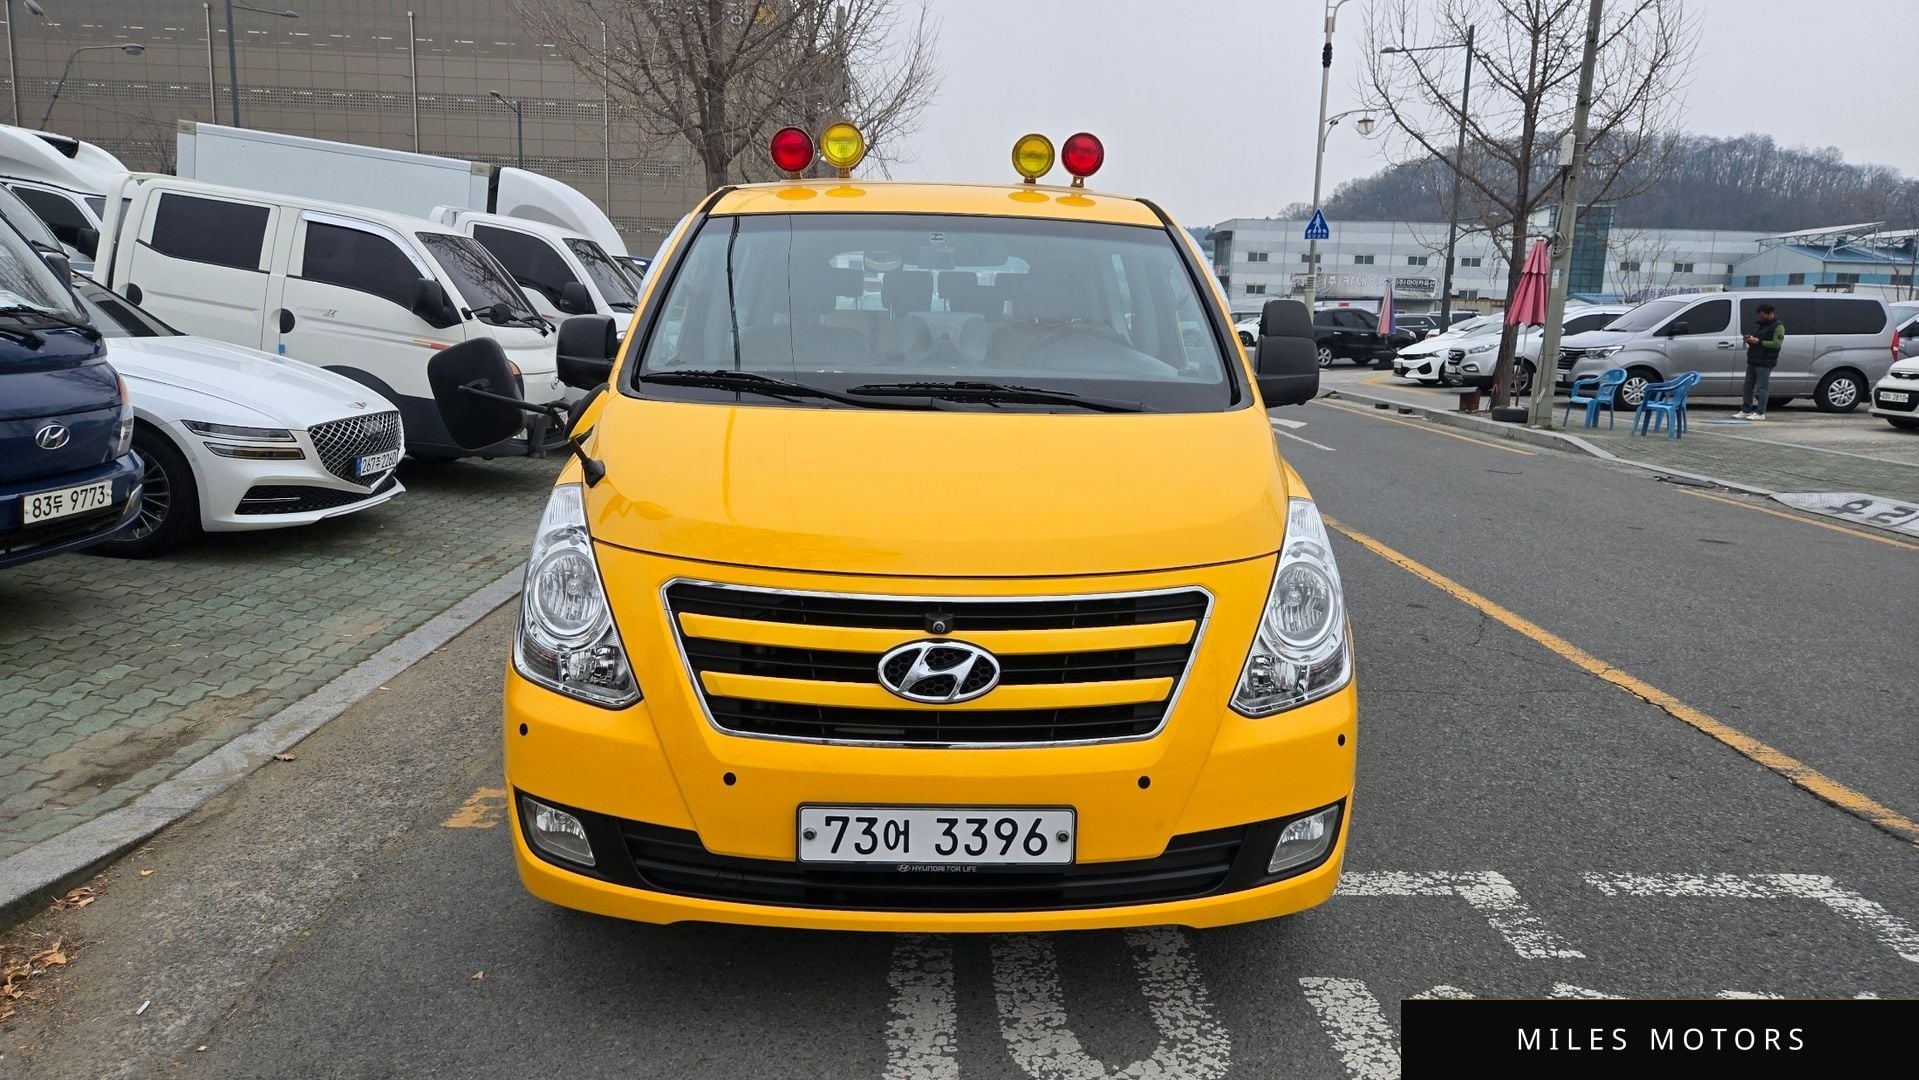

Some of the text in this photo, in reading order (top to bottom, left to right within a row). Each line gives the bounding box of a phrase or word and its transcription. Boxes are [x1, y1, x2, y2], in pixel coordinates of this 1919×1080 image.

[381, 451, 397, 469] 2260
[32, 484, 106, 518] 83두 9773
[824, 815, 1048, 856] 73어 3396
